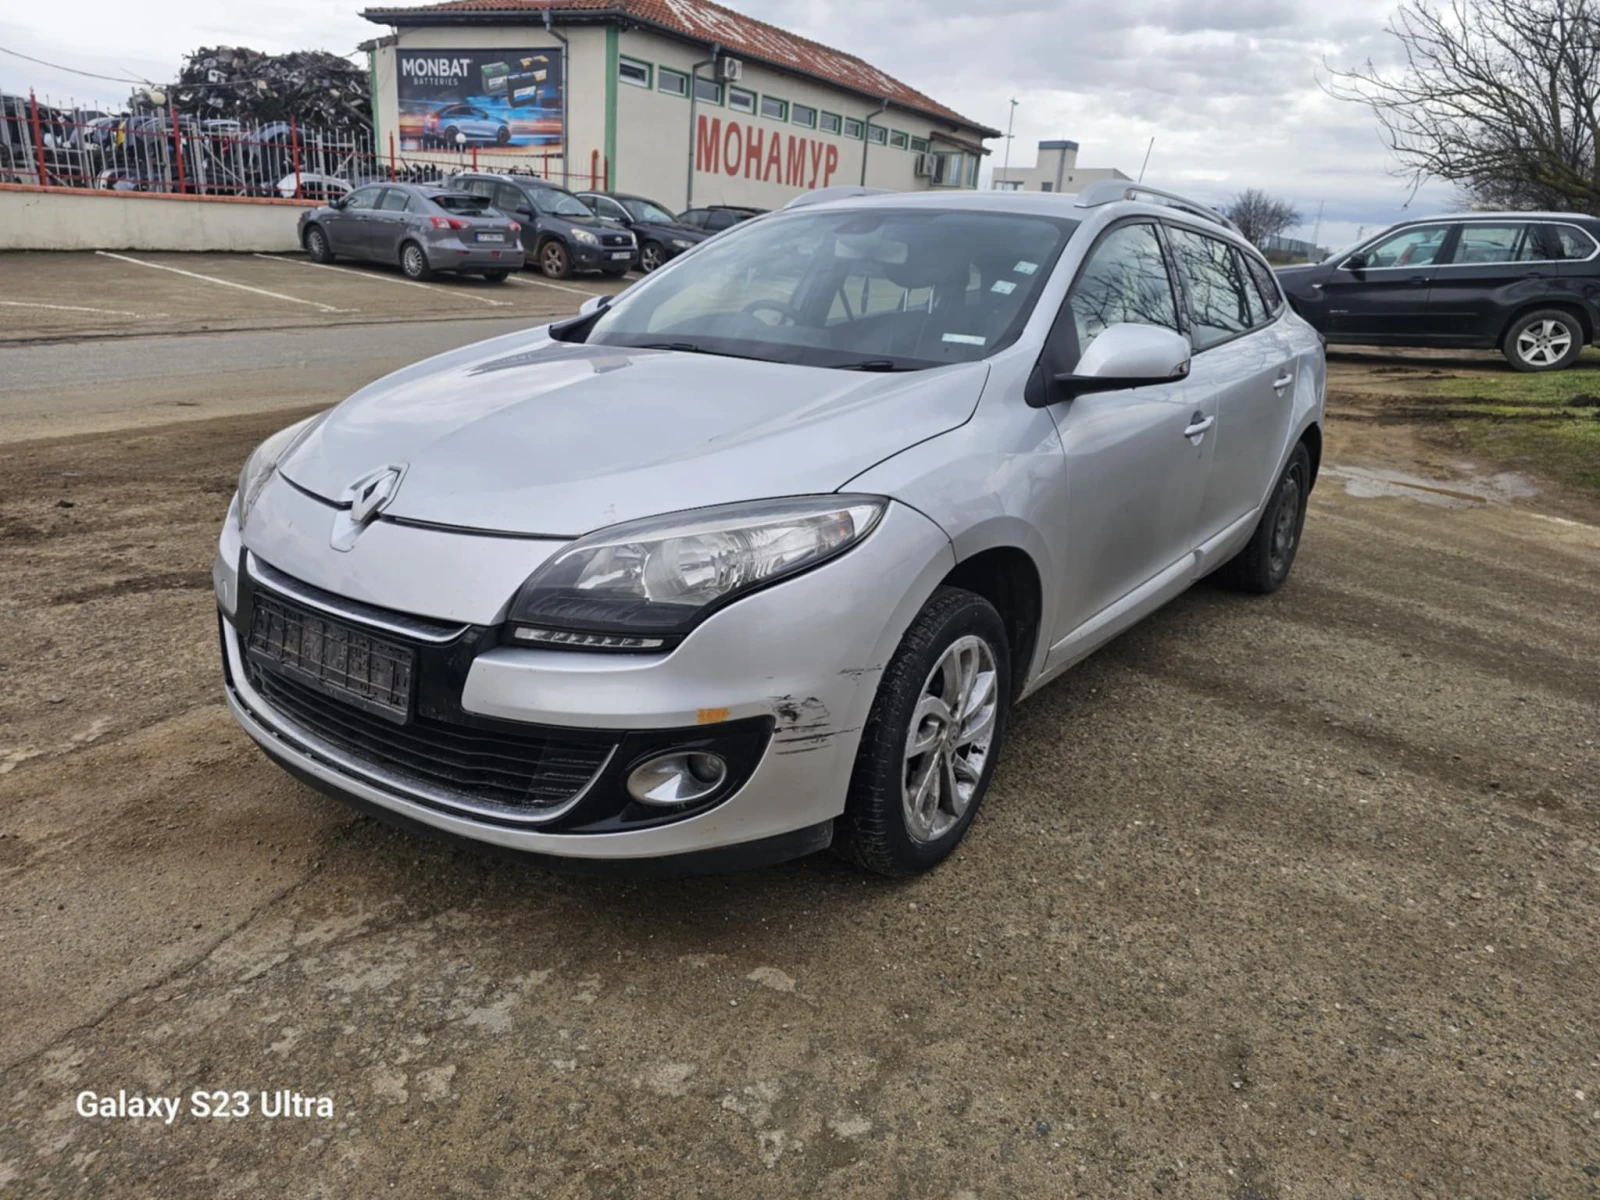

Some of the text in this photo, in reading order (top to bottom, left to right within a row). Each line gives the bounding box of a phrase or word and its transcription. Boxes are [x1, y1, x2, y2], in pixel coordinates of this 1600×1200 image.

[402, 58, 470, 77] MONBAT
[413, 77, 459, 86] BATTERIES
[696, 114, 839, 189] МОНАМУР
